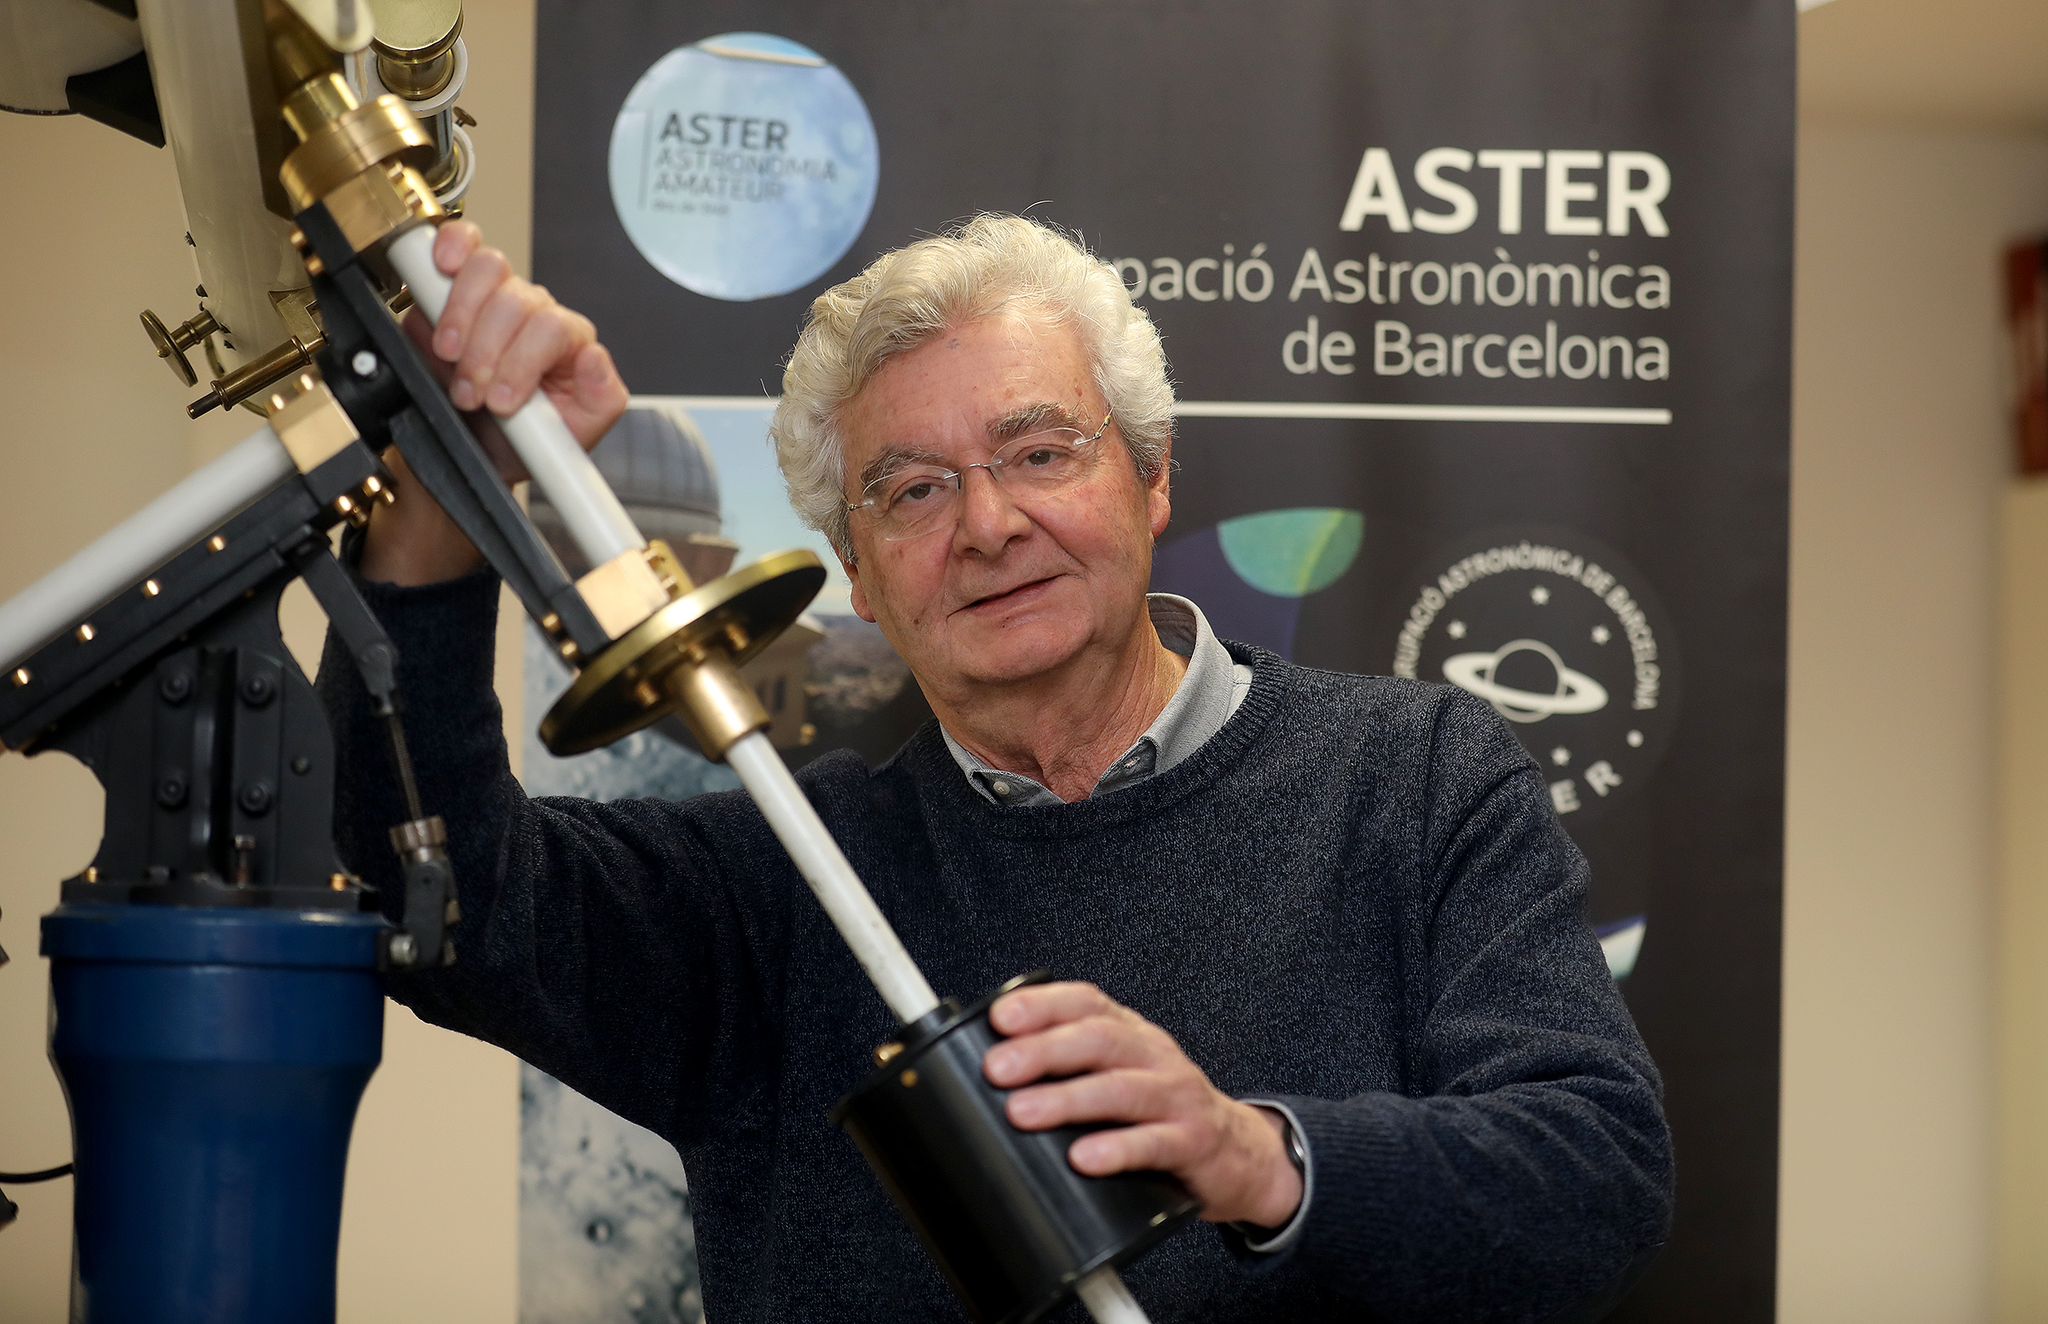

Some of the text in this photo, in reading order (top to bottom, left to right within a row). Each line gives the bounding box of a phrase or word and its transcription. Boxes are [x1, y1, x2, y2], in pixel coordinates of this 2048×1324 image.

[658, 111, 790, 151] ASTER
[653, 173, 786, 203] AMATEUR
[654, 149, 838, 181] ASTRONOMIA
[1339, 147, 1671, 237] ASTER
[1114, 243, 1671, 309] pació Astronòmica
[1281, 315, 1670, 380] de Barcelona
[1392, 584, 1447, 679] RUPACIÓ
[1580, 562, 1616, 598] DE
